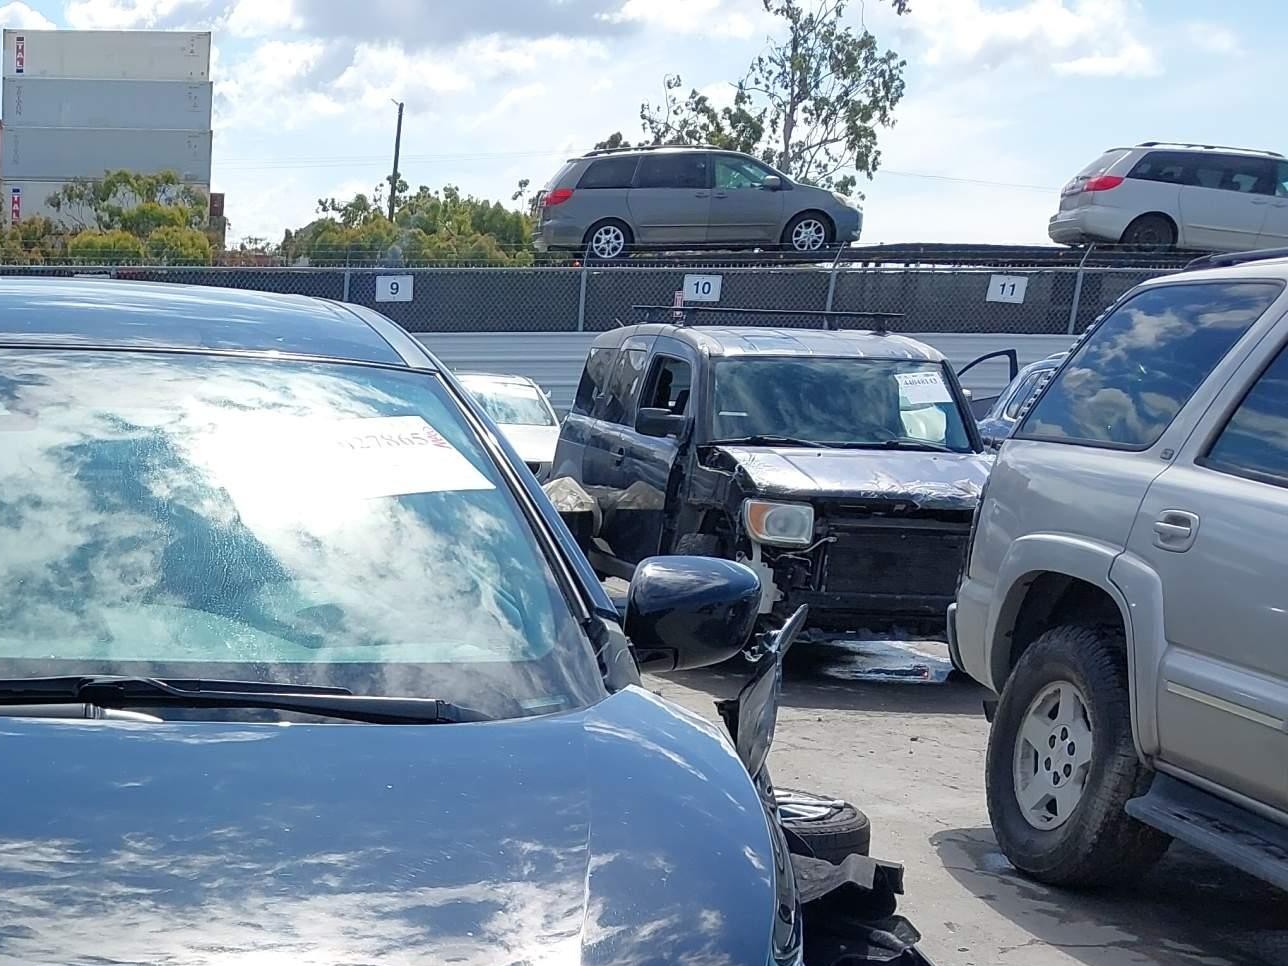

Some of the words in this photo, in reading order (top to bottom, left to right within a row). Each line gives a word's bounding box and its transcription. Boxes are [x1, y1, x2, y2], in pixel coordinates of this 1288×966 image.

[16, 43, 24, 68] TAL
[390, 282, 399, 295] 9
[694, 281, 711, 295] 10
[999, 282, 1016, 297] 11
